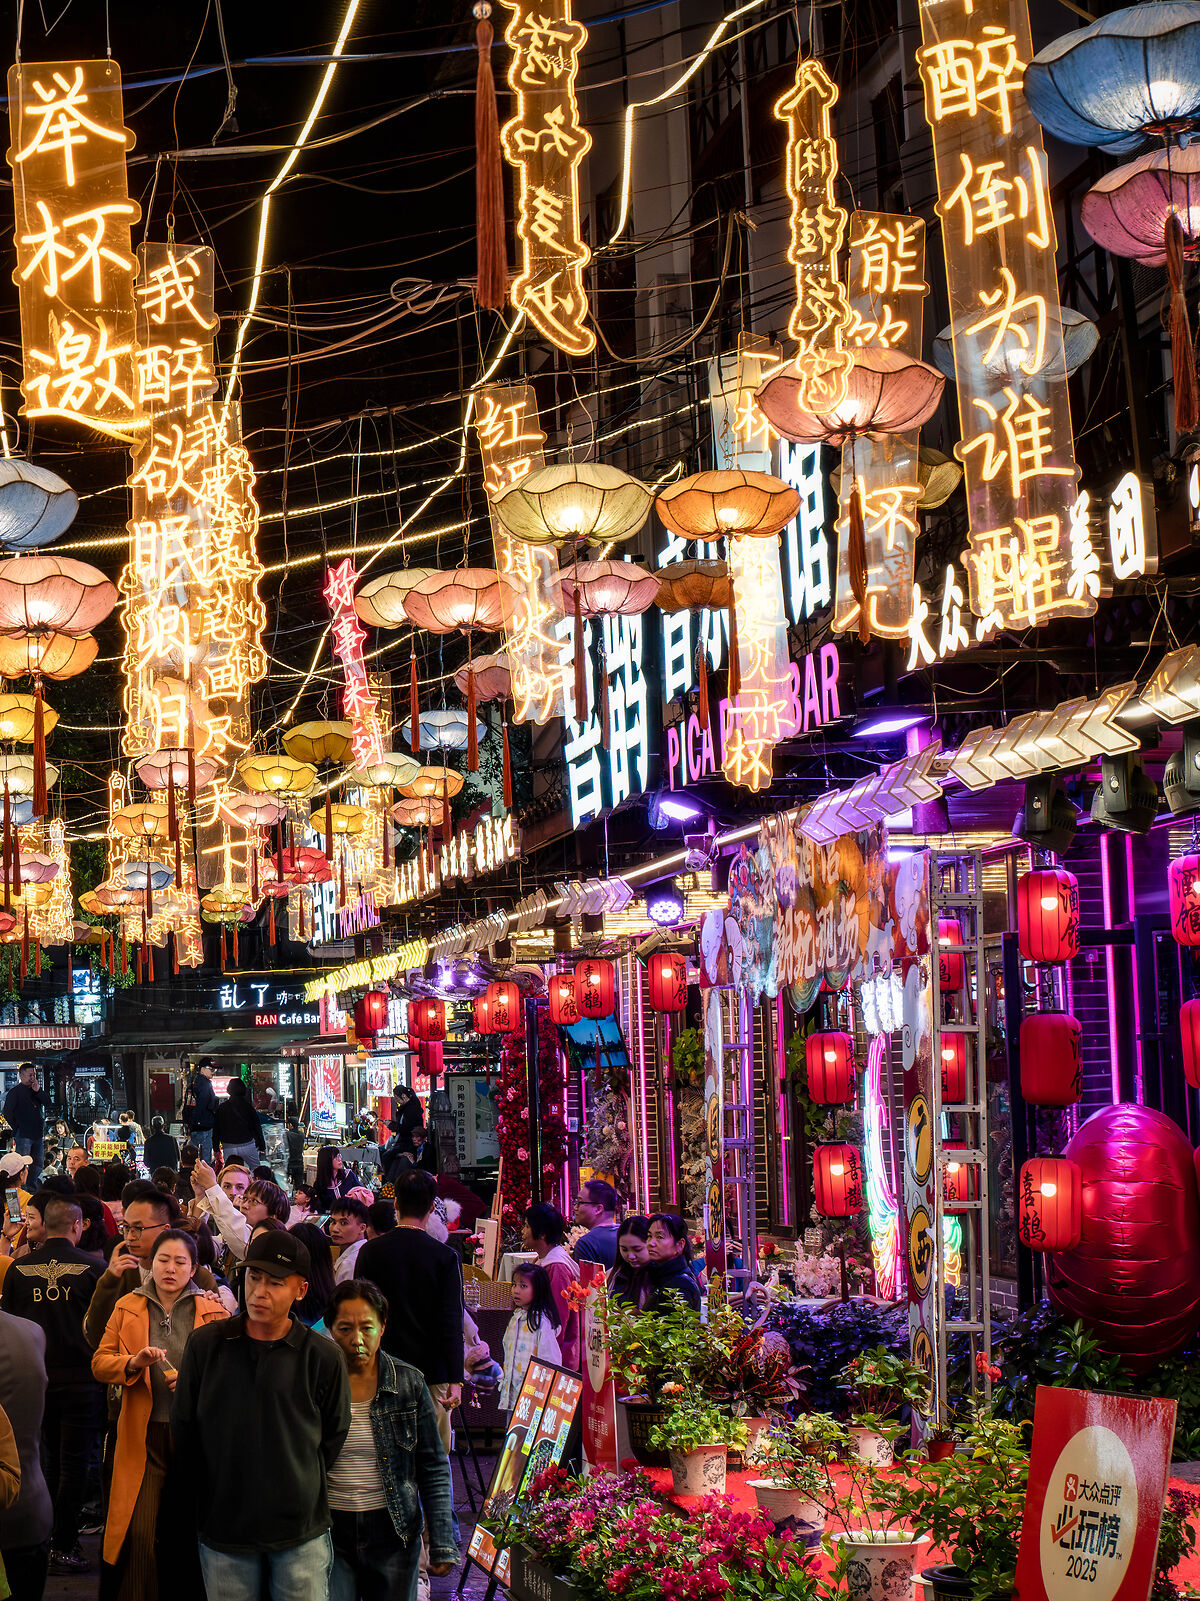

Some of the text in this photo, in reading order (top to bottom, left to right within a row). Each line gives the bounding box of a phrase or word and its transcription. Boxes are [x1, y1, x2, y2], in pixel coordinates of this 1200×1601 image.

[16, 66, 149, 430] 举杯邀
[926, 0, 1087, 620] 醉倒为谁醒
[789, 642, 840, 738] BAR
[220, 985, 269, 1009] 乱了
[255, 1014, 277, 1025] RAN
[280, 1013, 302, 1025] Café
[1019, 1170, 1046, 1242] 喜鹊
[33, 1286, 71, 1302] BOY
[1078, 1481, 1122, 1507] 大众点评
[1051, 1505, 1122, 1558] 必玩榜
[1065, 1556, 1098, 1583] 2025
